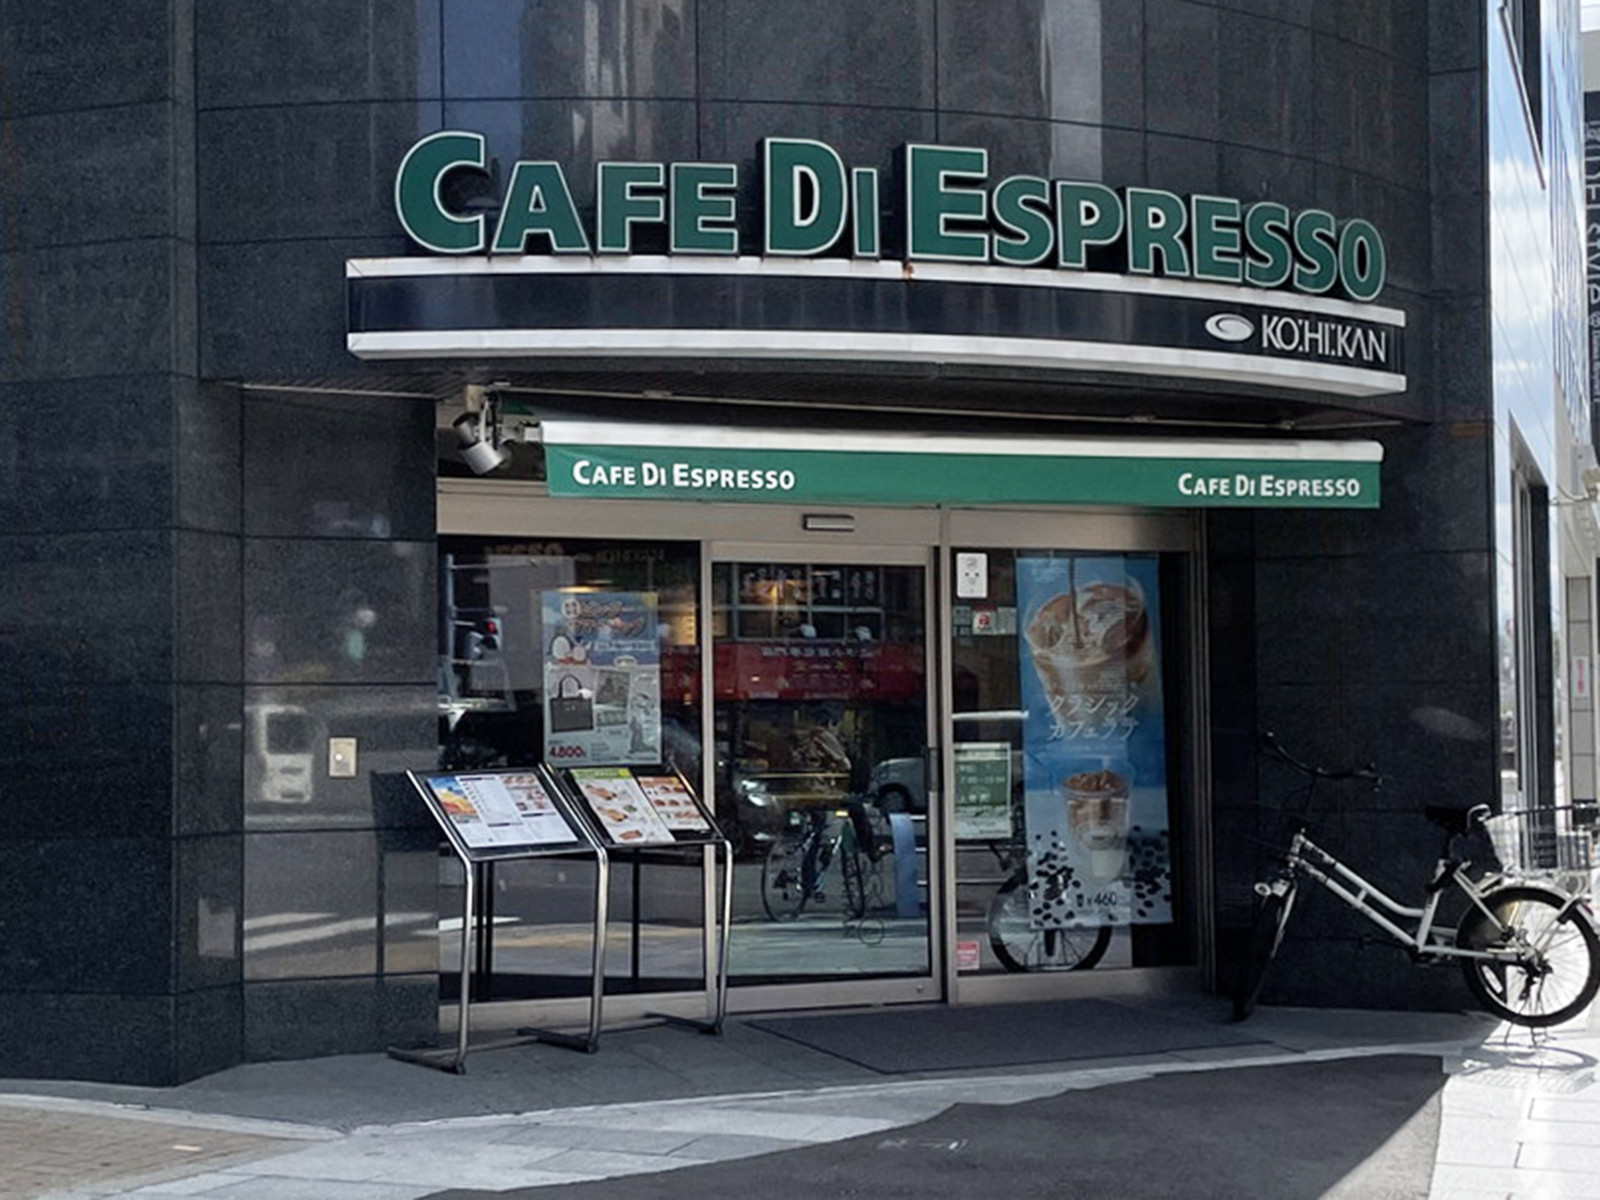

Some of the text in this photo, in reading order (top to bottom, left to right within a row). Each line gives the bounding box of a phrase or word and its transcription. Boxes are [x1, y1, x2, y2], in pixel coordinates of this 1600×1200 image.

[908, 144, 1386, 301] ESPRESSO
[673, 463, 795, 490] ESPRESSO
[1260, 474, 1361, 497] ESPRESSO
